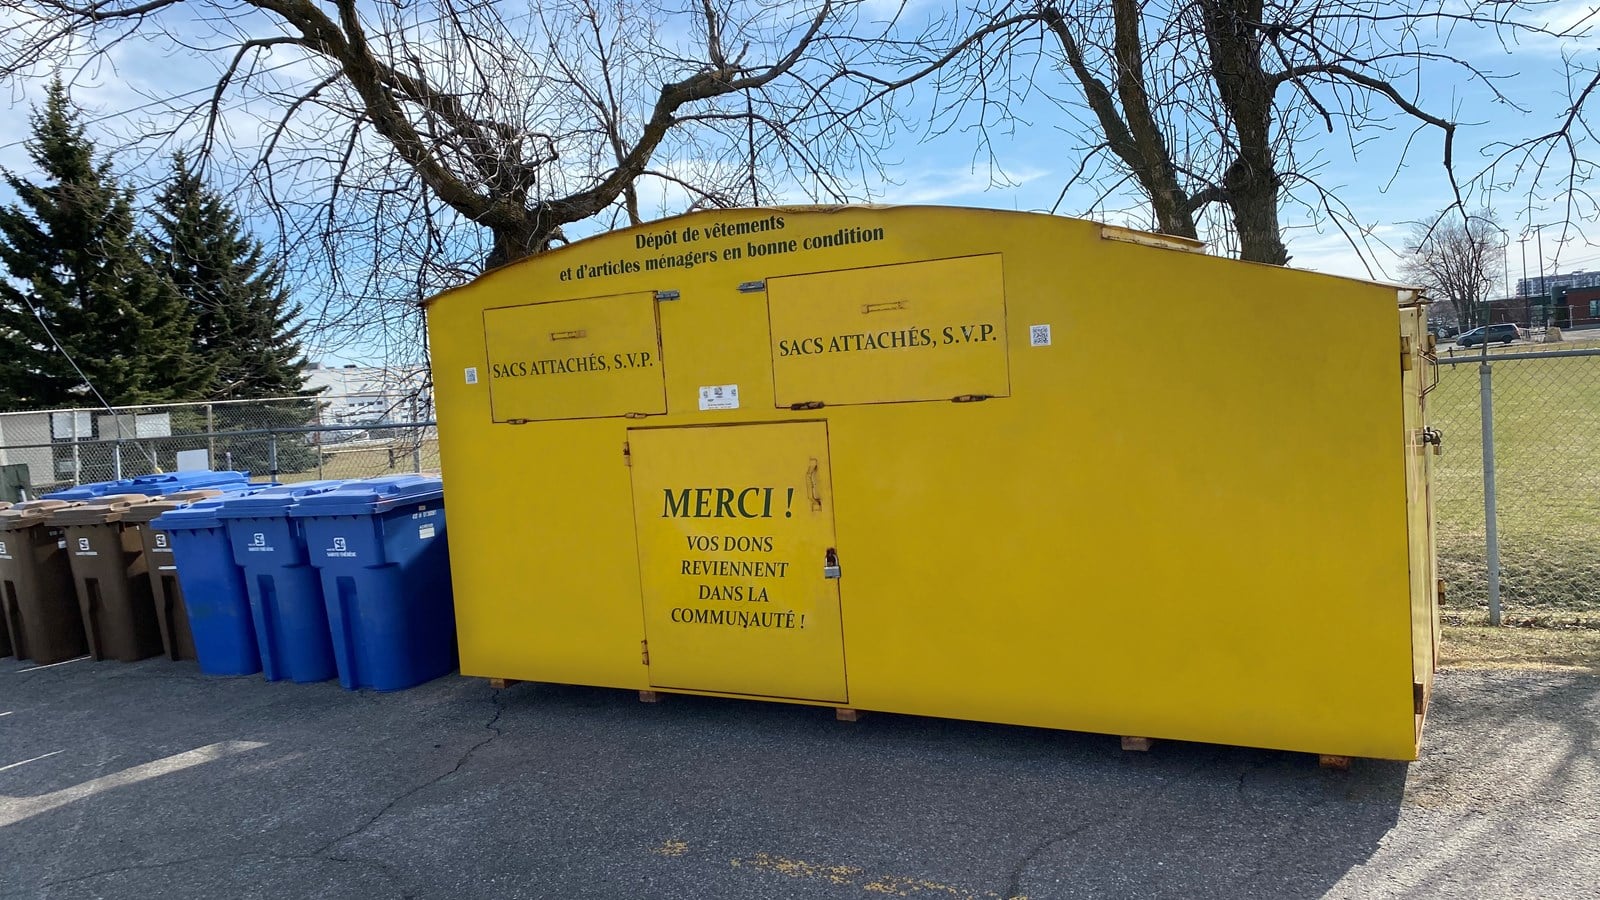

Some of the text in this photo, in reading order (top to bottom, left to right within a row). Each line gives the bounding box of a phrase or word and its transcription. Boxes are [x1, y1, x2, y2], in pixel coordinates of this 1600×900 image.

[635, 215, 785, 251] Dépôt de vêtements
[559, 268, 572, 282] et
[645, 251, 718, 270] ménagers
[723, 248, 742, 261] en
[747, 240, 798, 258] bonne
[802, 226, 884, 250] condition
[779, 323, 997, 357] SACS ATTACHÉS, S.V.P.
[493, 351, 653, 379] SACS ATTACHÉS, S.V.P.
[661, 487, 775, 519] MERCI
[686, 535, 773, 553] VOS DONS
[681, 559, 789, 578] REVIENNENT
[698, 584, 769, 603] DANS LA
[671, 608, 796, 629] COMMUNAUTÉ
